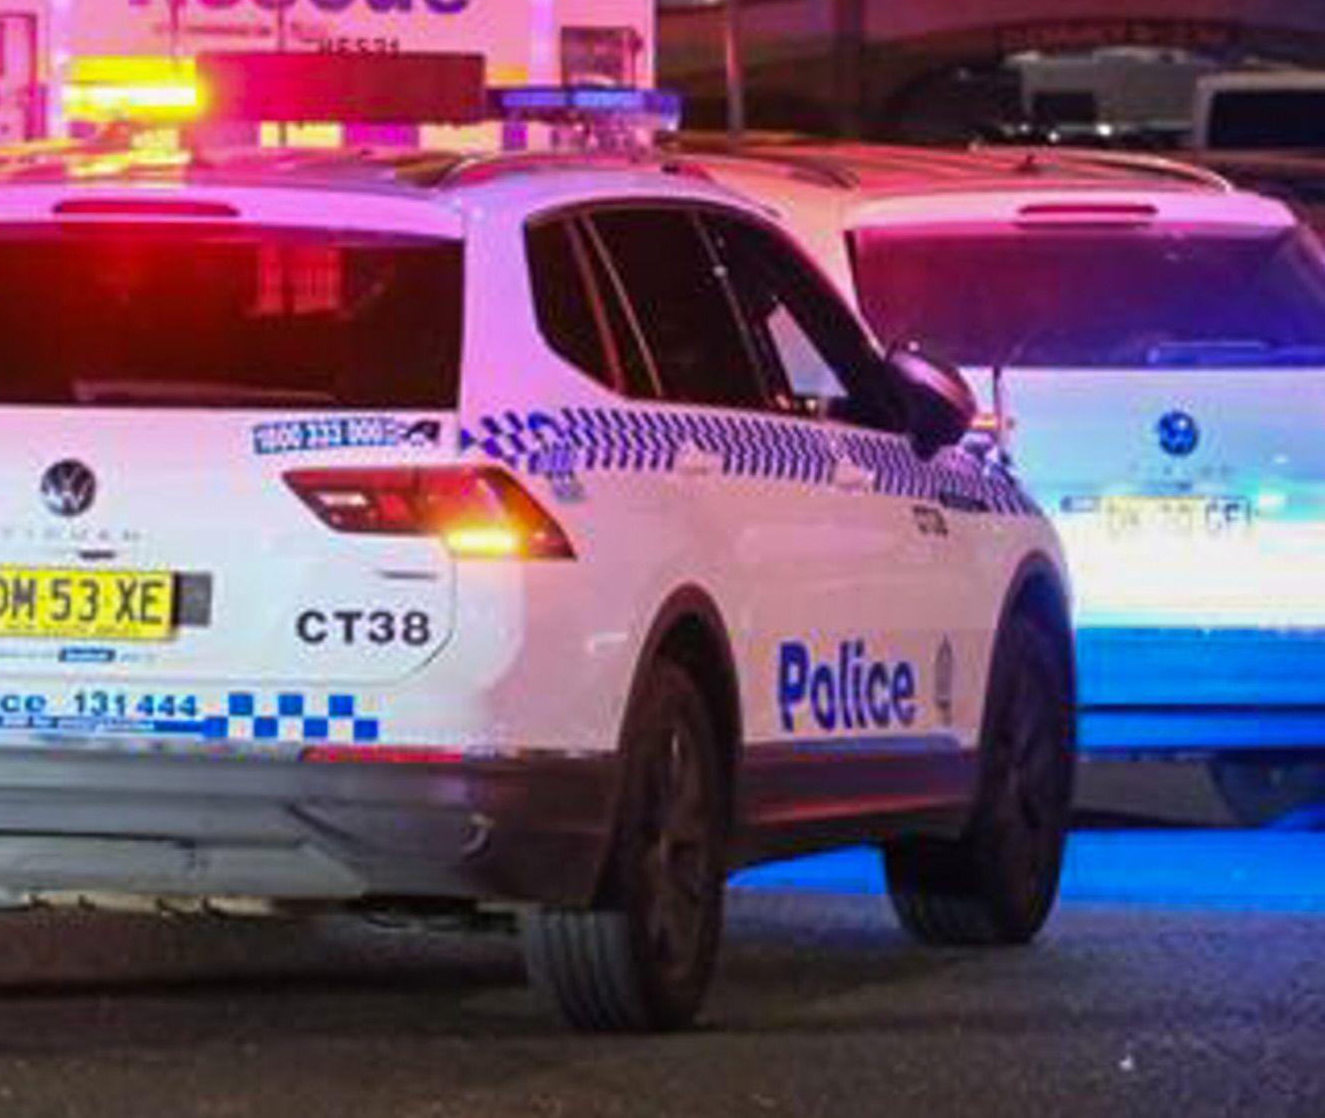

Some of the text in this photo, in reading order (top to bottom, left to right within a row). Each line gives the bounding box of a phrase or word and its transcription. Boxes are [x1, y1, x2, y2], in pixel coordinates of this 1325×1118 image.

[50, 577, 101, 623] 53
[116, 579, 166, 626] XE
[295, 609, 431, 647] CT38
[779, 636, 917, 732] Police
